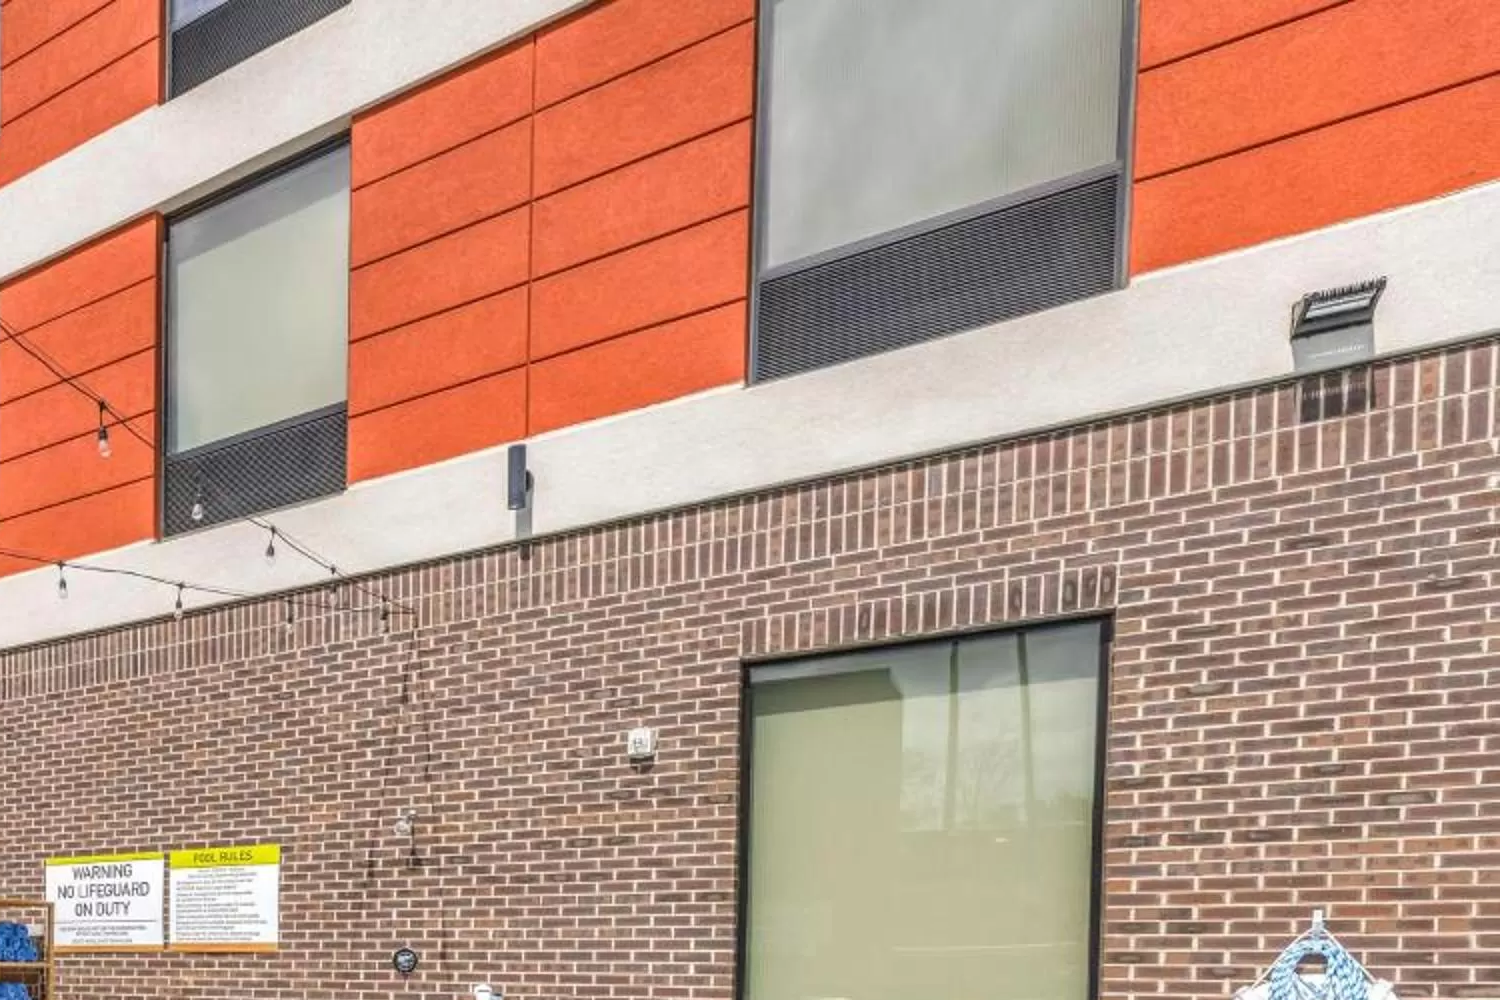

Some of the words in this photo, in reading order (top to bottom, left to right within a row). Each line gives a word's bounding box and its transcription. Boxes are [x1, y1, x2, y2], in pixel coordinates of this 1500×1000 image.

[72, 863, 133, 880] WARNING
[57, 884, 75, 899] NO
[77, 881, 151, 898] LIFEGUARD
[74, 902, 93, 917] ON
[95, 900, 131, 917] DUTY
